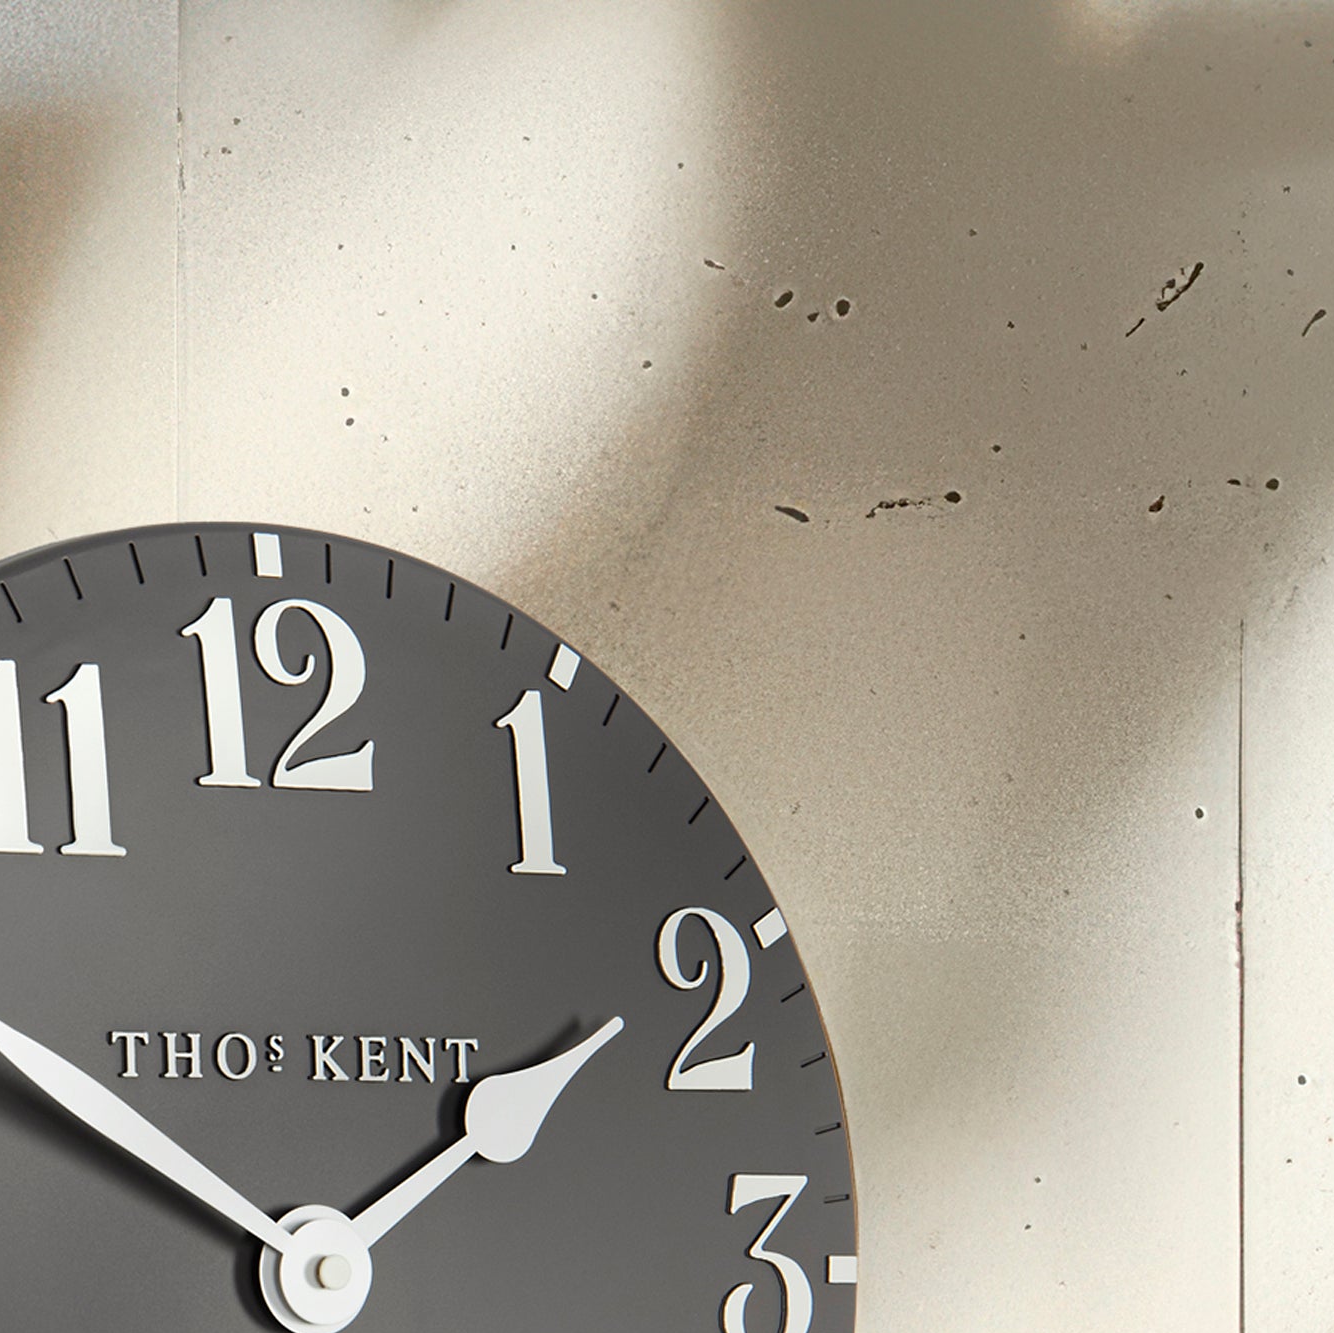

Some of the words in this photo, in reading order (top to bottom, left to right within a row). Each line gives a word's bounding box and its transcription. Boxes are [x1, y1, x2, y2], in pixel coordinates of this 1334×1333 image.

[181, 597, 375, 793] 12
[496, 689, 568, 876] 1
[312, 1034, 480, 1084] KENT
[657, 906, 756, 1092] 2
